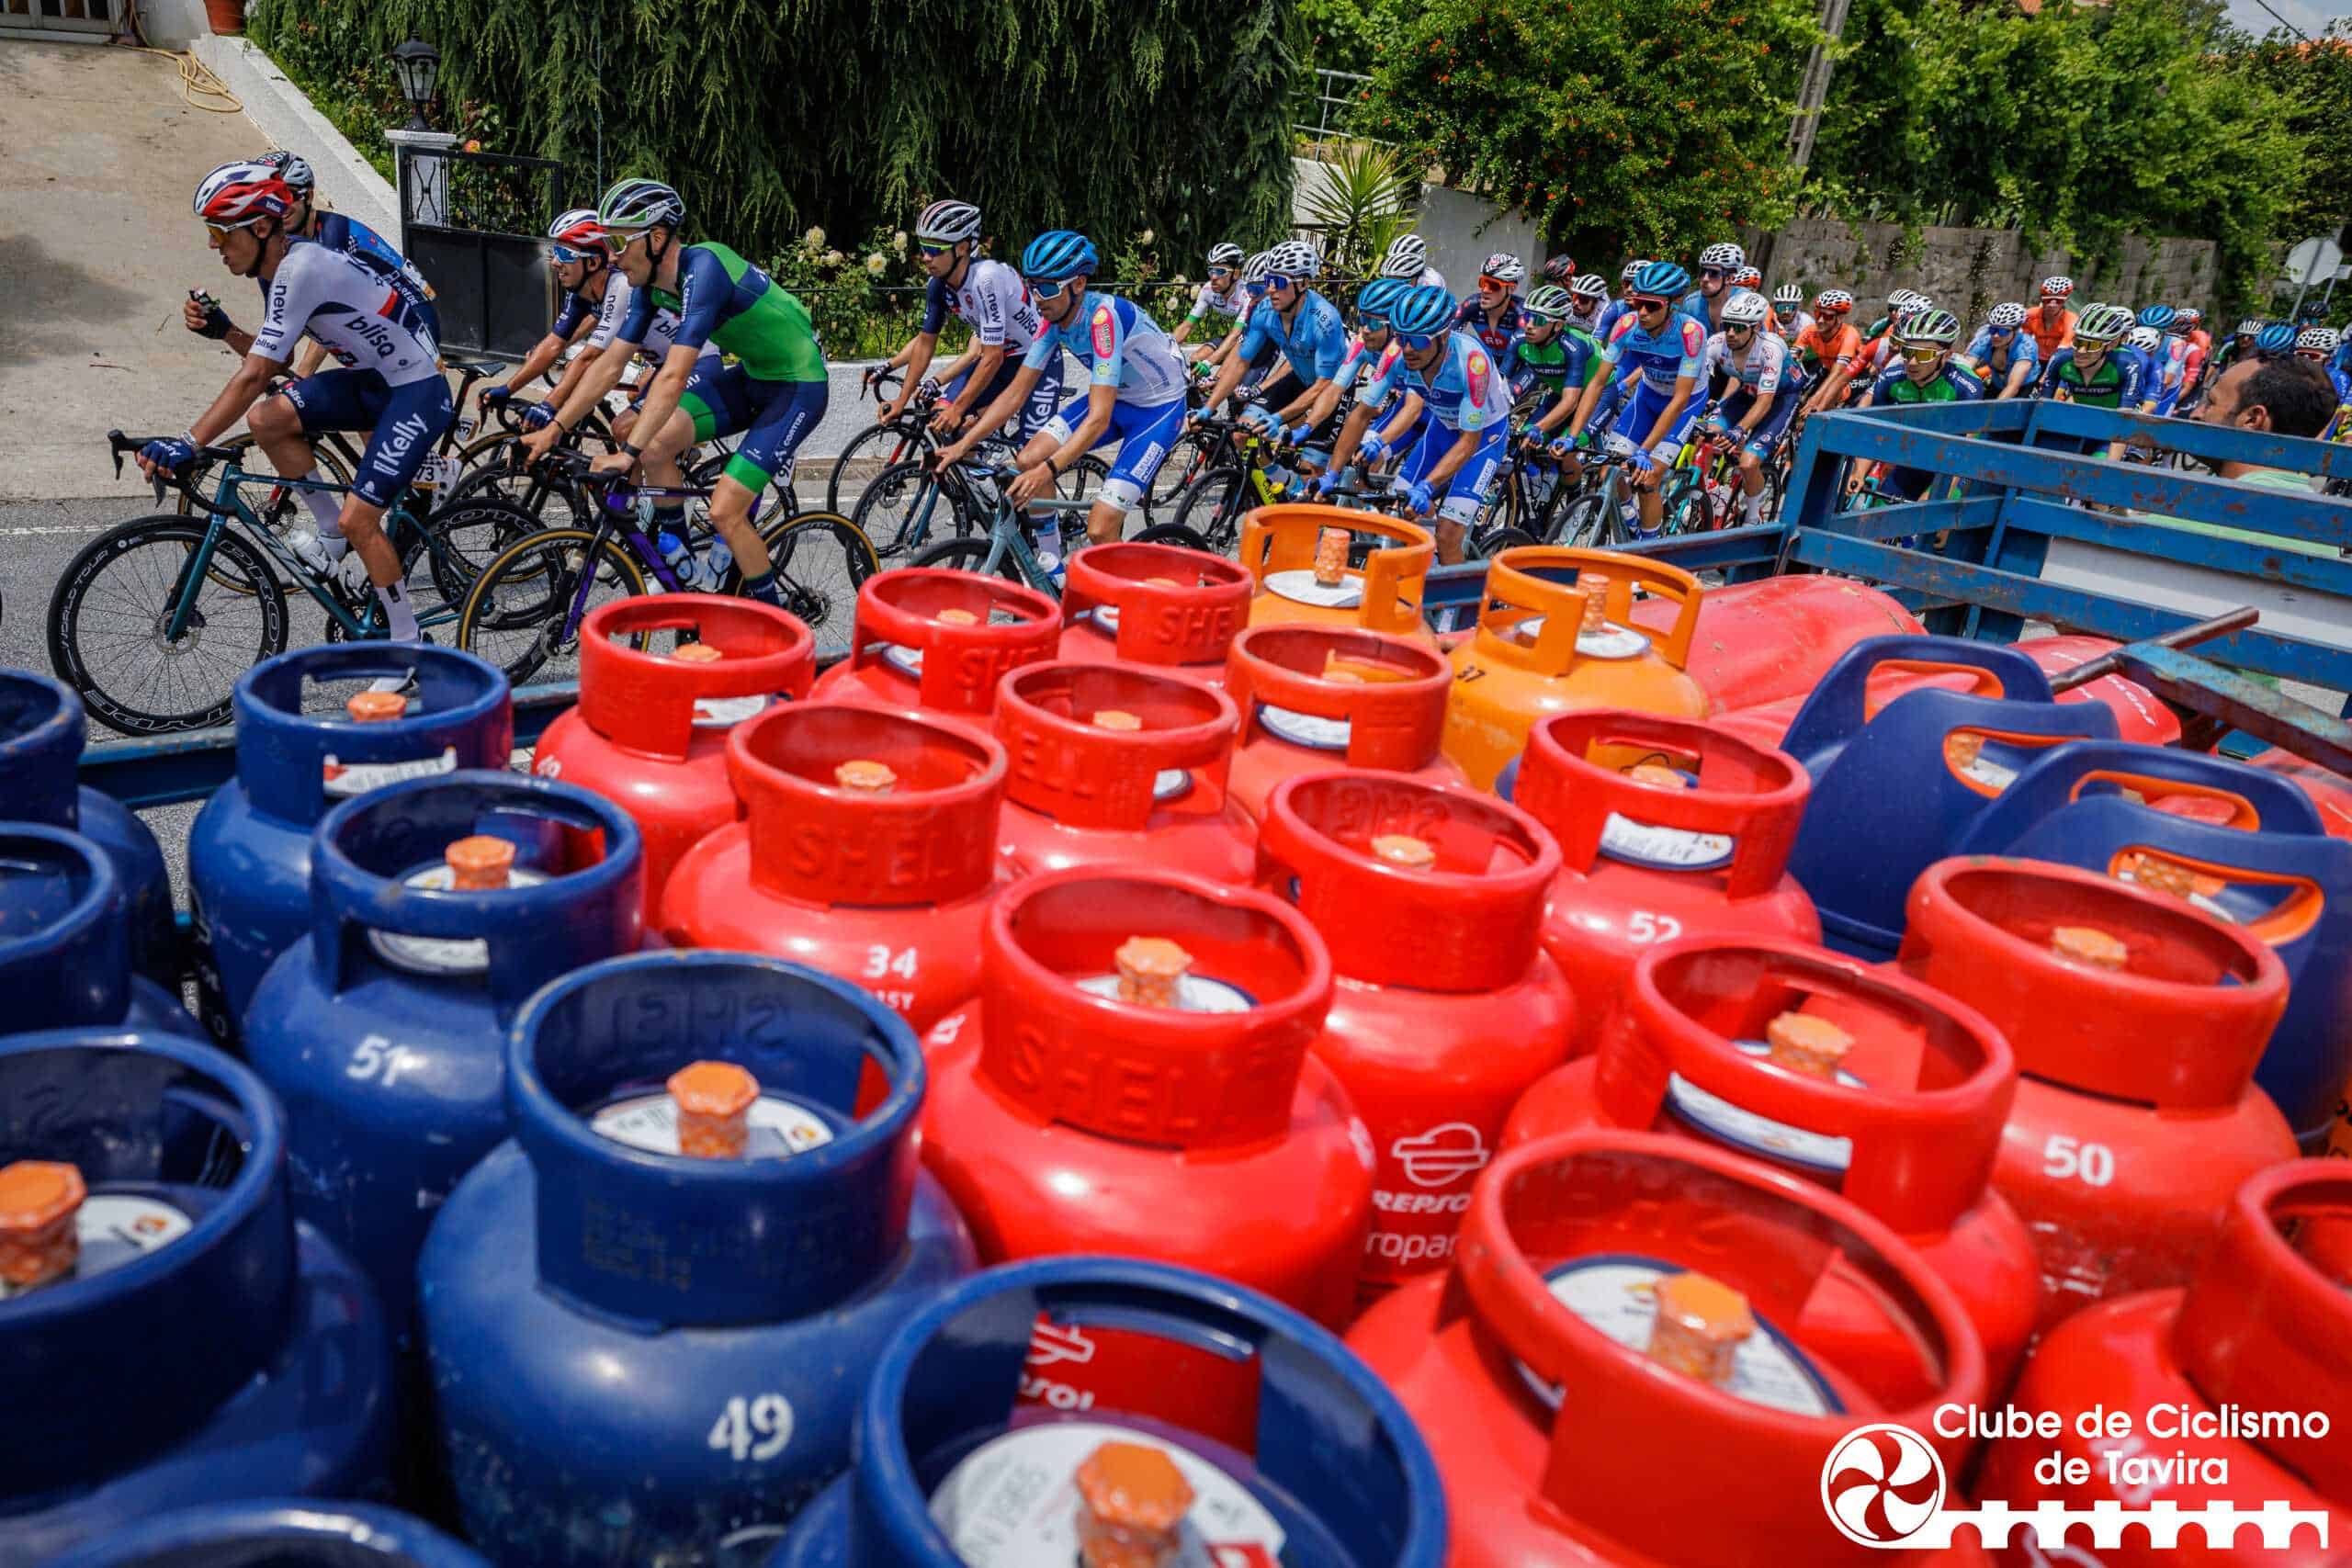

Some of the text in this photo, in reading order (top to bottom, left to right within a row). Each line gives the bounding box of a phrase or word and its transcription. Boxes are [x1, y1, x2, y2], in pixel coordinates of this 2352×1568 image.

[345, 316, 395, 358] blisq
[1013, 307, 1039, 336] blisq
[255, 337, 277, 351] blisq
[1023, 376, 1061, 430] Kelly
[378, 412, 429, 470] Kelly
[458, 418, 471, 435] 31
[783, 412, 807, 447] CORTIZO
[415, 465, 435, 482] 73
[74, 549, 109, 586] TOUR
[1154, 603, 1235, 646] SHE
[1626, 910, 1682, 944] 52
[862, 943, 918, 980] 34
[345, 1034, 410, 1088] 51
[2042, 1134, 2116, 1187] 50
[1372, 1189, 1473, 1214] REPSO
[707, 1393, 795, 1461] 49
